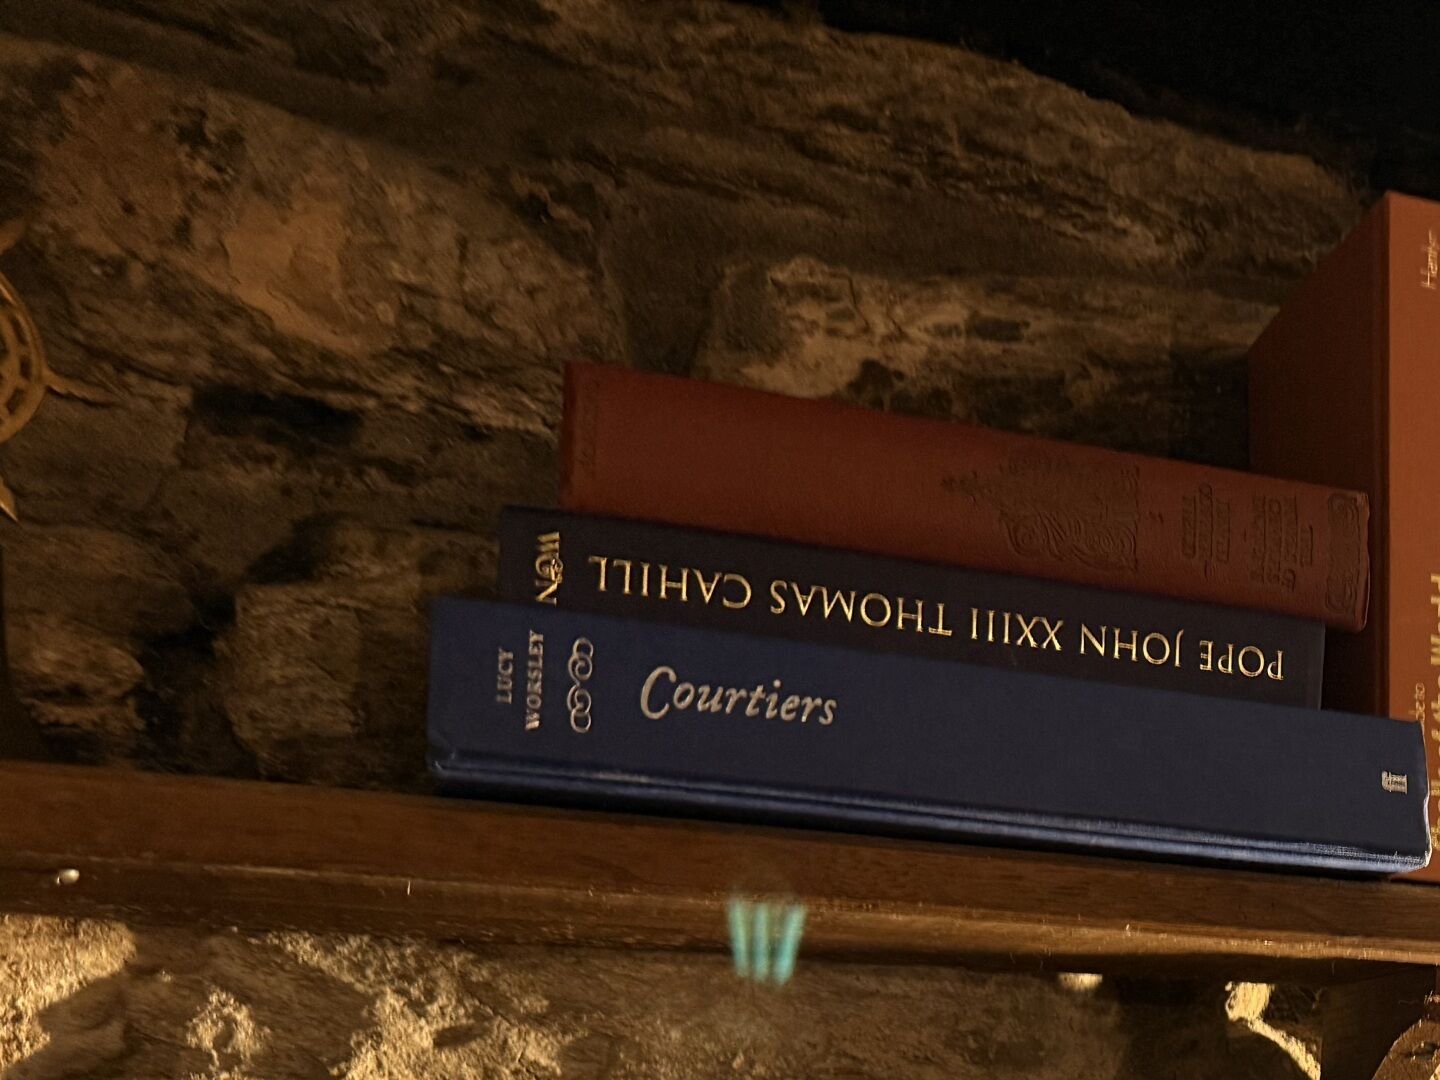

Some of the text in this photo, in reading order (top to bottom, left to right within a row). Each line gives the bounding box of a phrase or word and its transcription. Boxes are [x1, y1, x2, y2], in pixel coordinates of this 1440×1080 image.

[588, 555, 1286, 681] POPE JOHN XXIII THOMAS CAHILL
[495, 647, 515, 704] LUCY
[525, 628, 545, 732] WORSLEY
[640, 665, 838, 727] Courtiers
